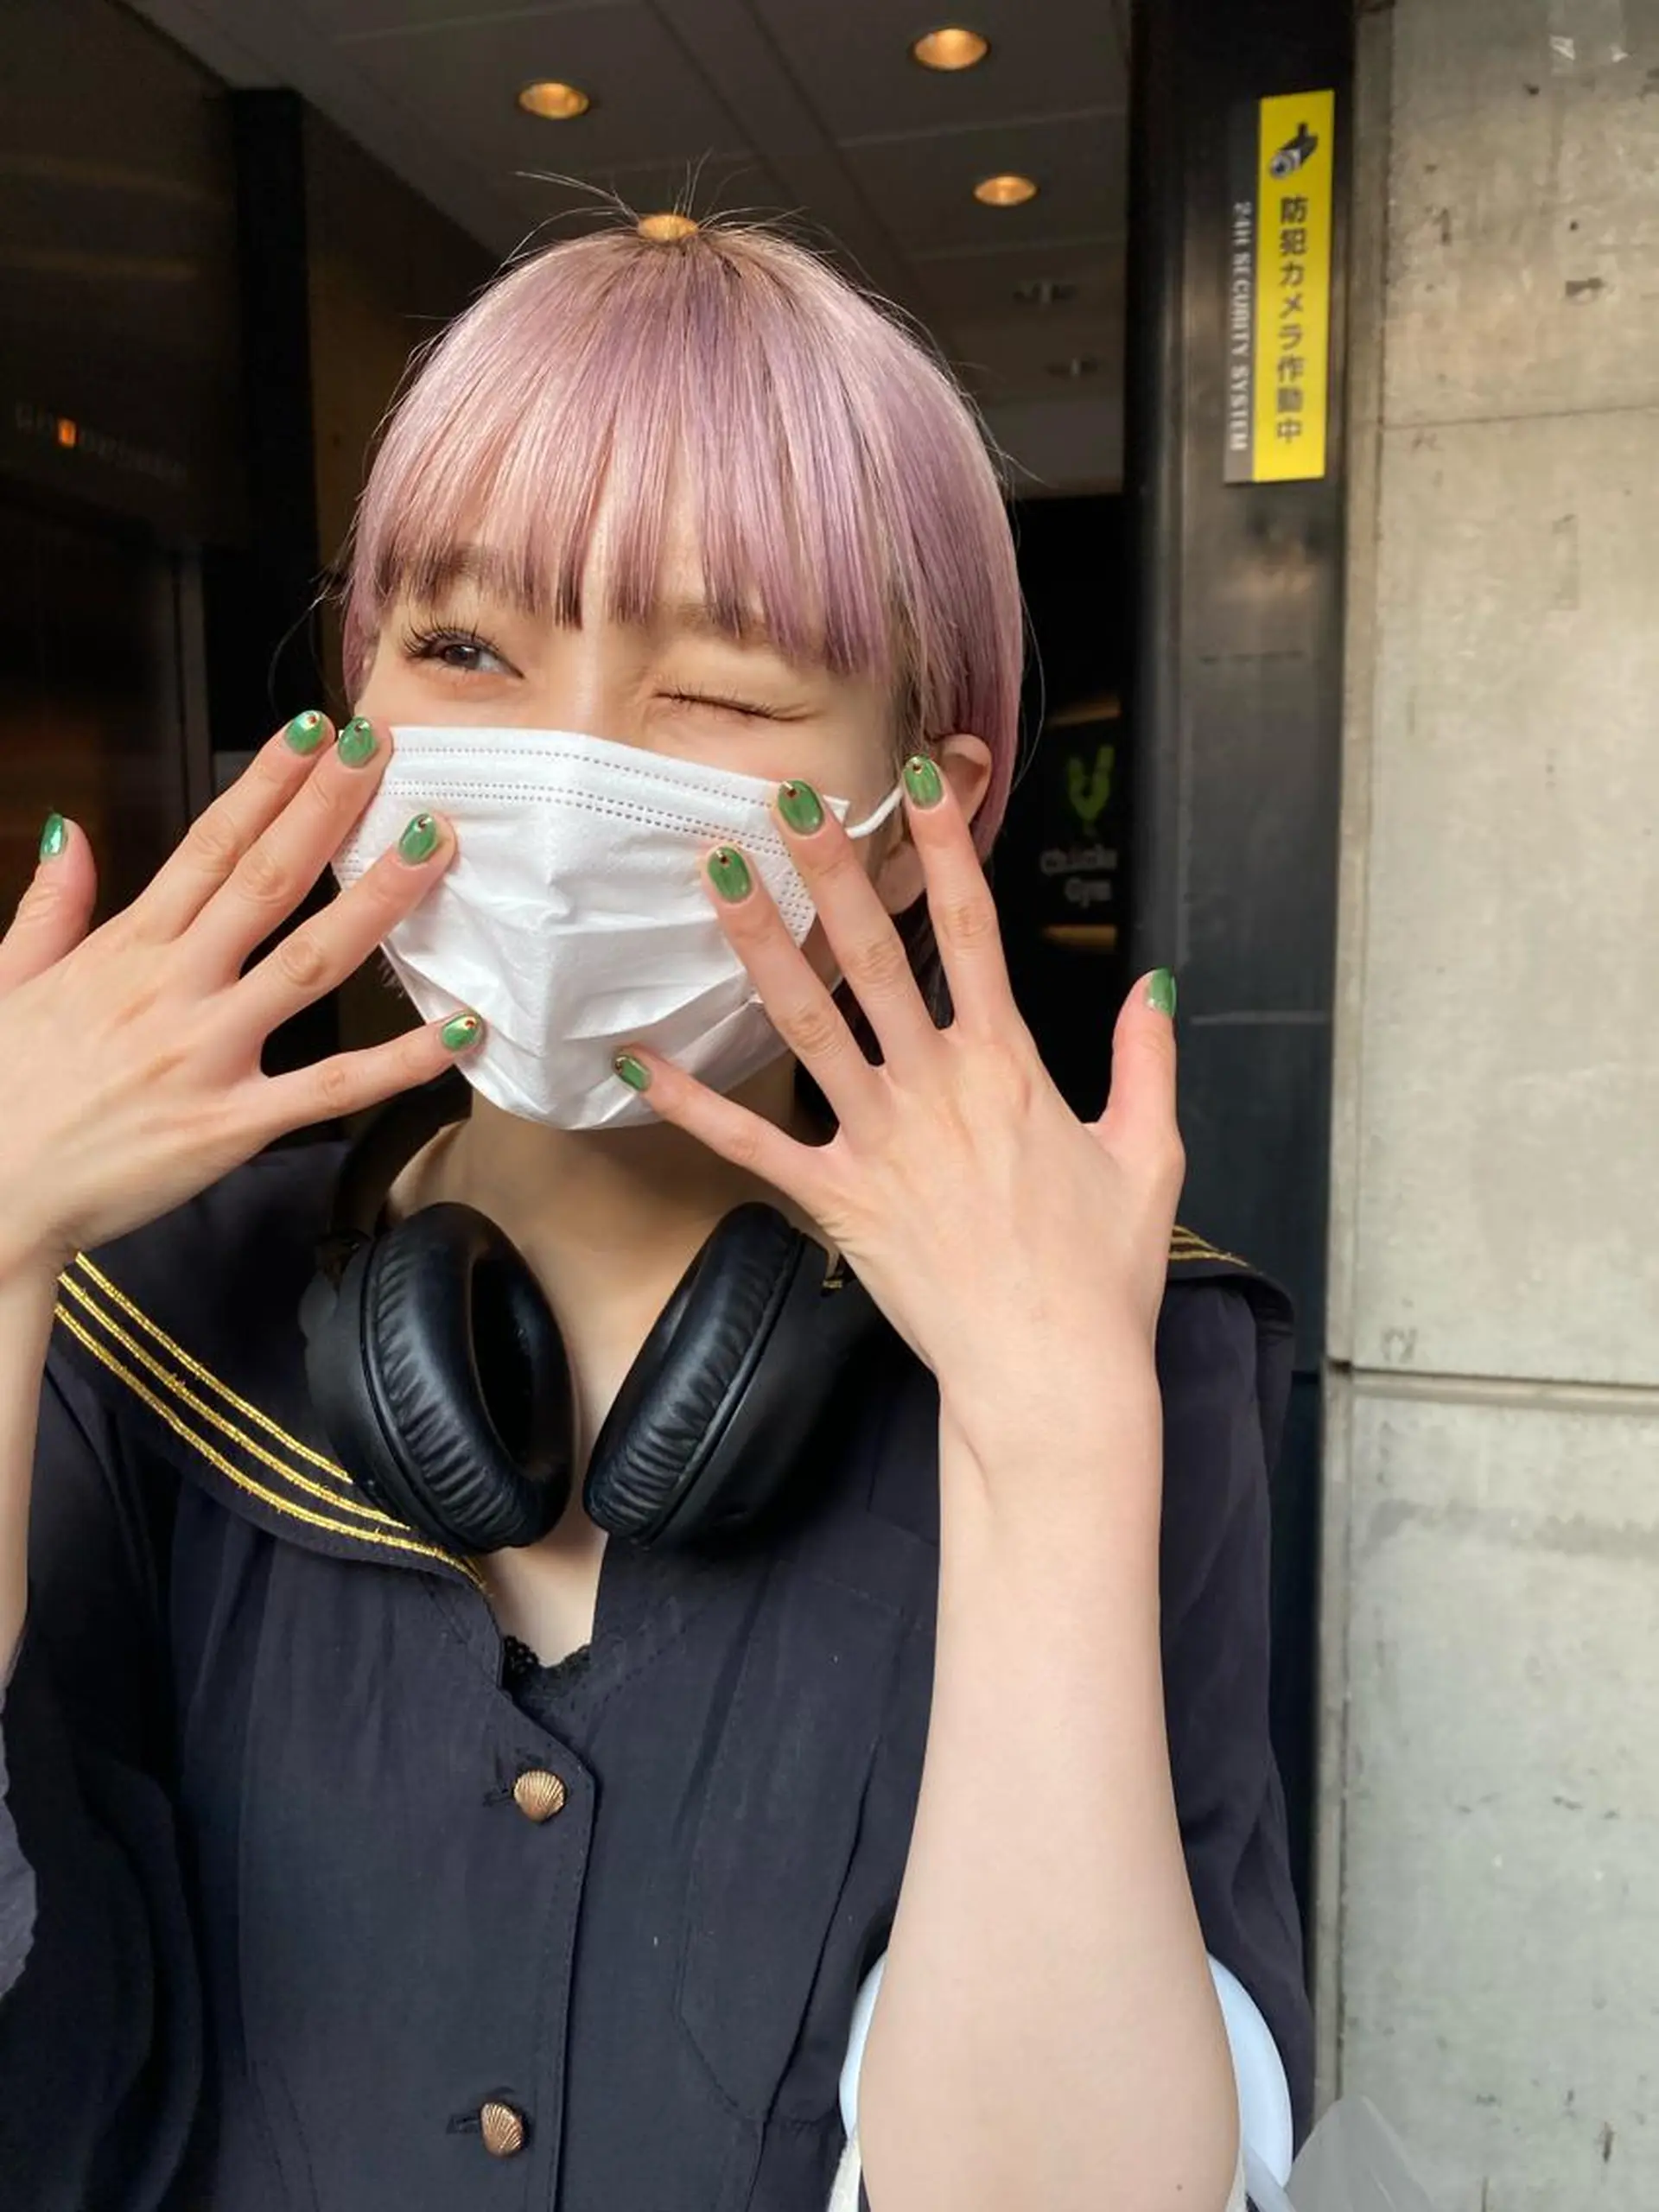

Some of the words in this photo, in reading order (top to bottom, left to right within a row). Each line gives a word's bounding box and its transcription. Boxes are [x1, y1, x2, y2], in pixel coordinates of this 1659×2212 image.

[1232, 200, 1252, 247] 24H
[1230, 253, 1251, 357] SECURITY
[1230, 365, 1249, 452] SYSTEM
